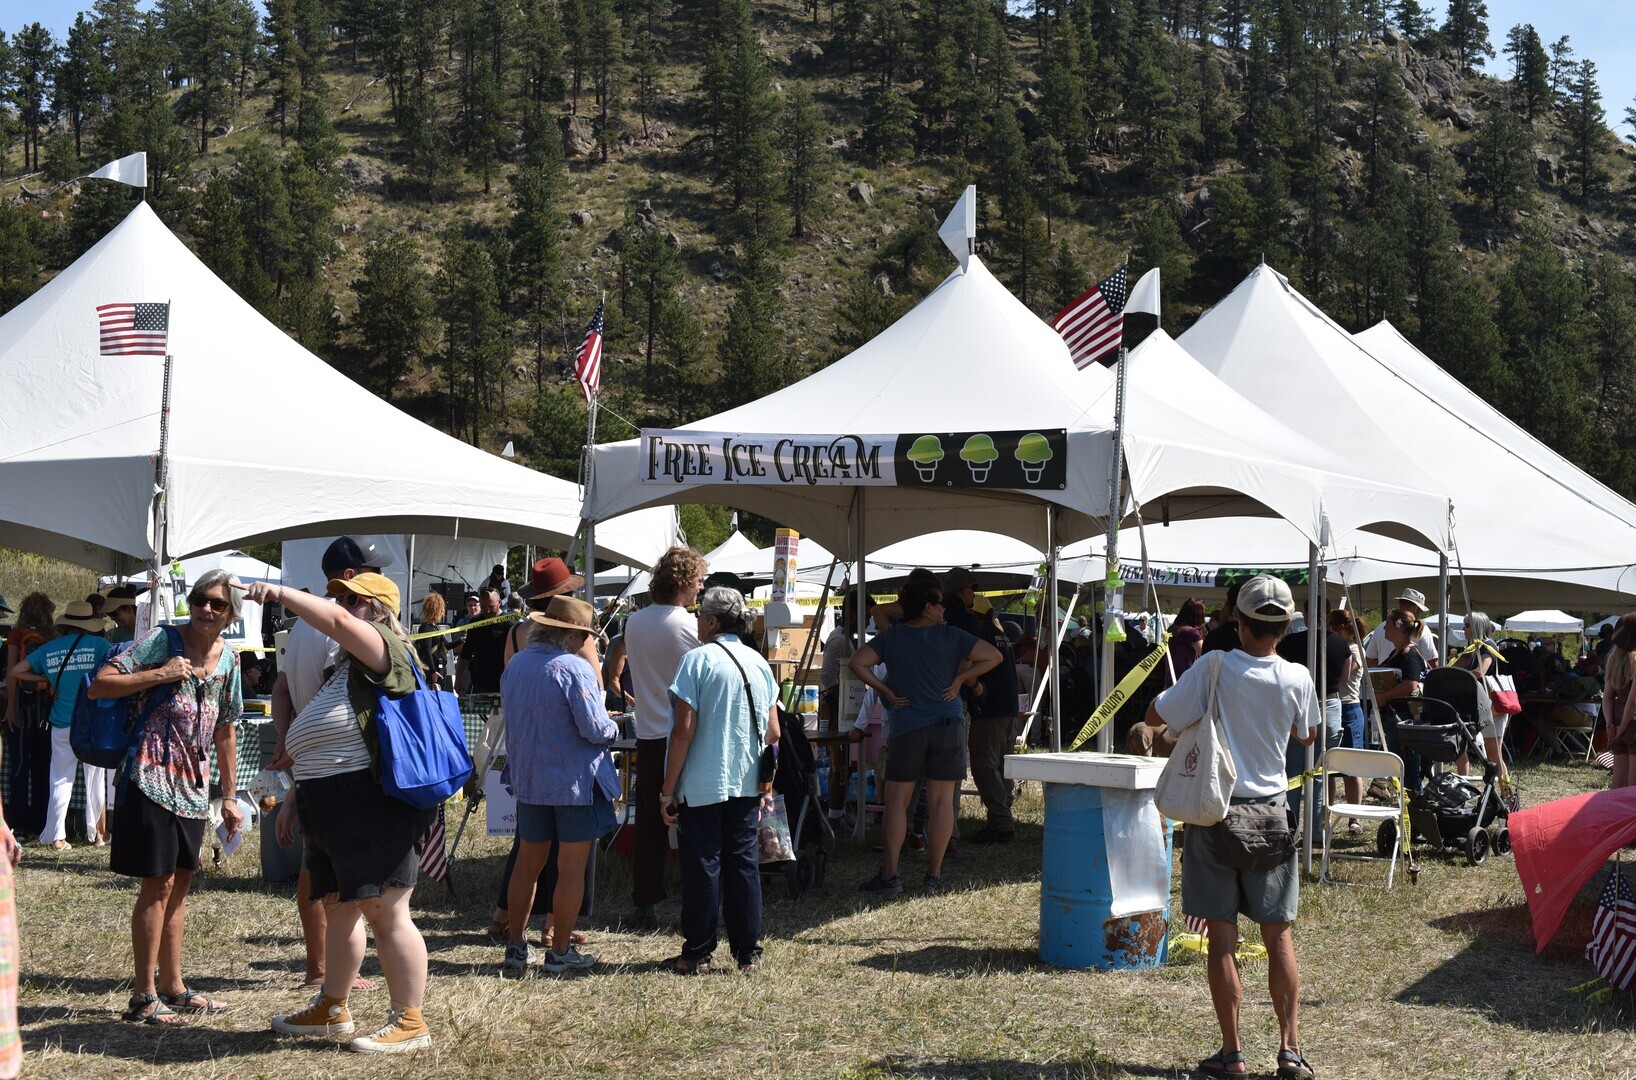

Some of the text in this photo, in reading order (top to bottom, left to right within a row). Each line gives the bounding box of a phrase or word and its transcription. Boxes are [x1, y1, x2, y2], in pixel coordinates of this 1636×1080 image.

[647, 434, 882, 485] FREE ICE CREAM
[46, 653, 95, 667] 303-75-6972
[1077, 645, 1165, 743] CAUTION CAUTION CAUTION
